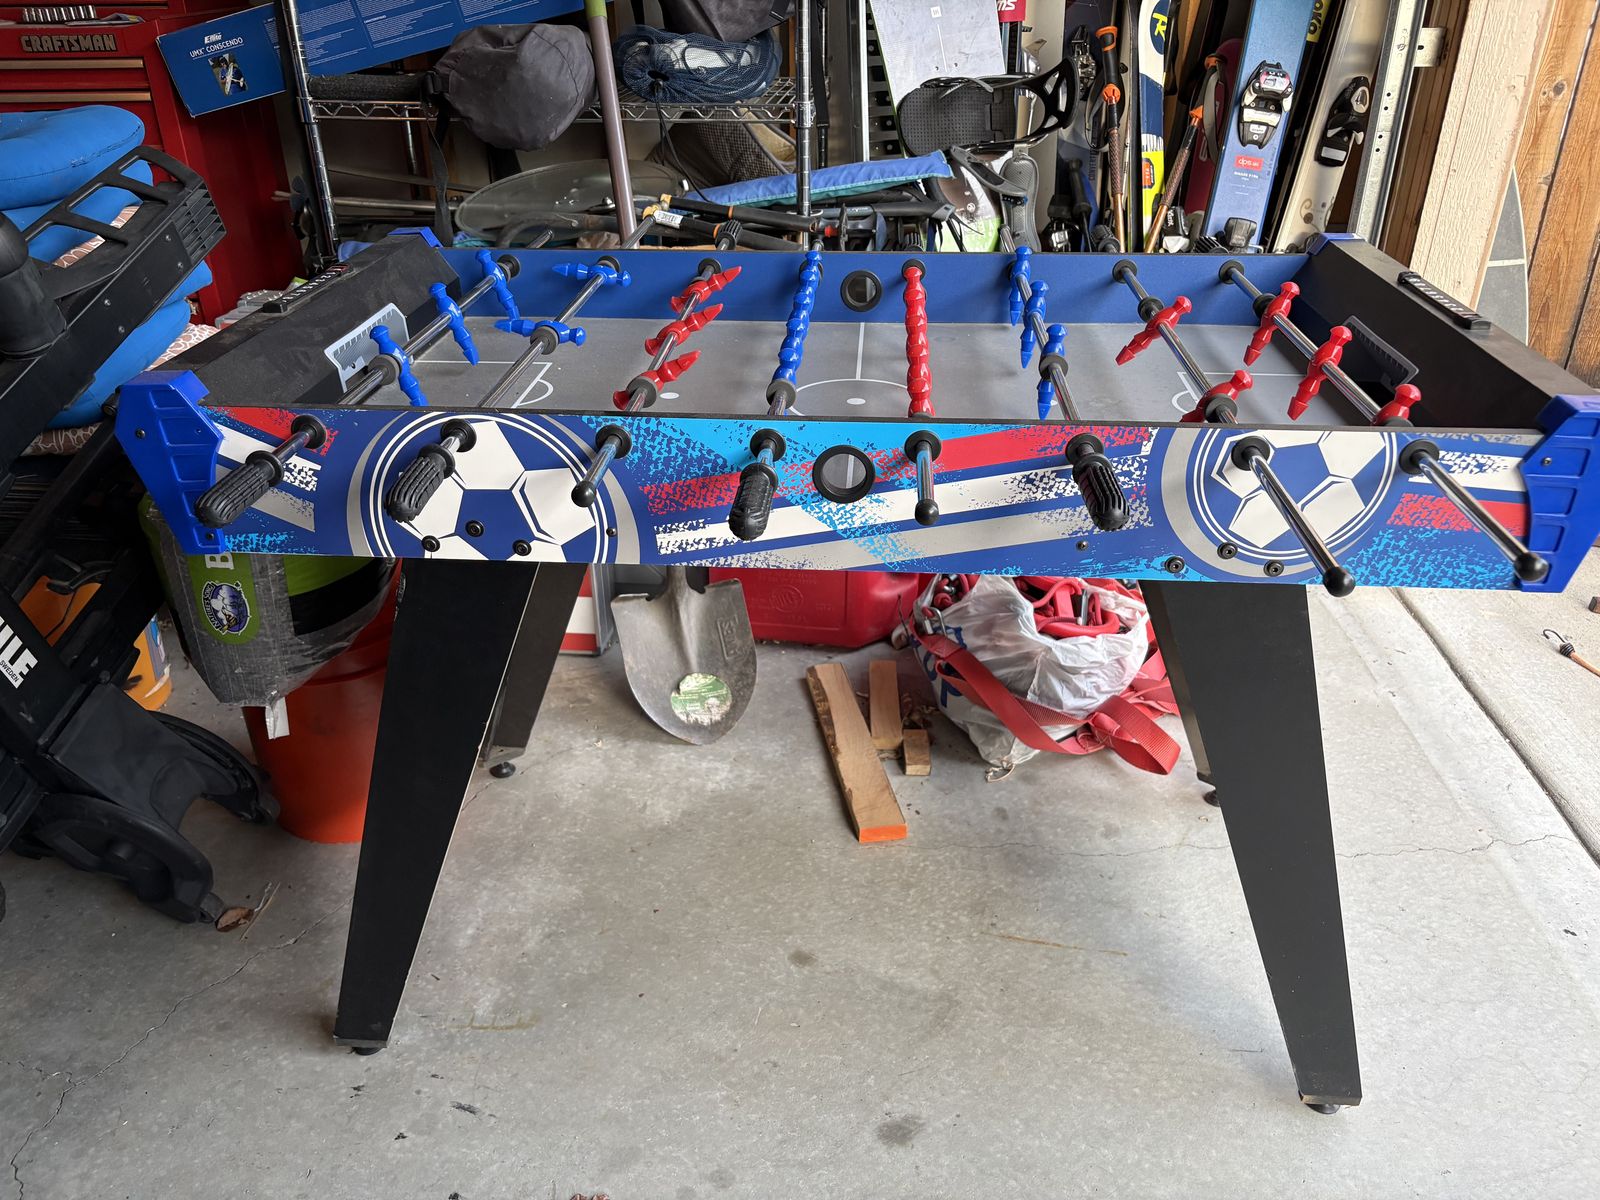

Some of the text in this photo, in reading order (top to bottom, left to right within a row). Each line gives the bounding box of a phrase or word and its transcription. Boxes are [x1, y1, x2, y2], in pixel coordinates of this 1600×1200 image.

[20, 34, 117, 53] CRAFTSMAN
[206, 37, 243, 53] CONSCENDO
[0, 660, 20, 683] SWEDEN
